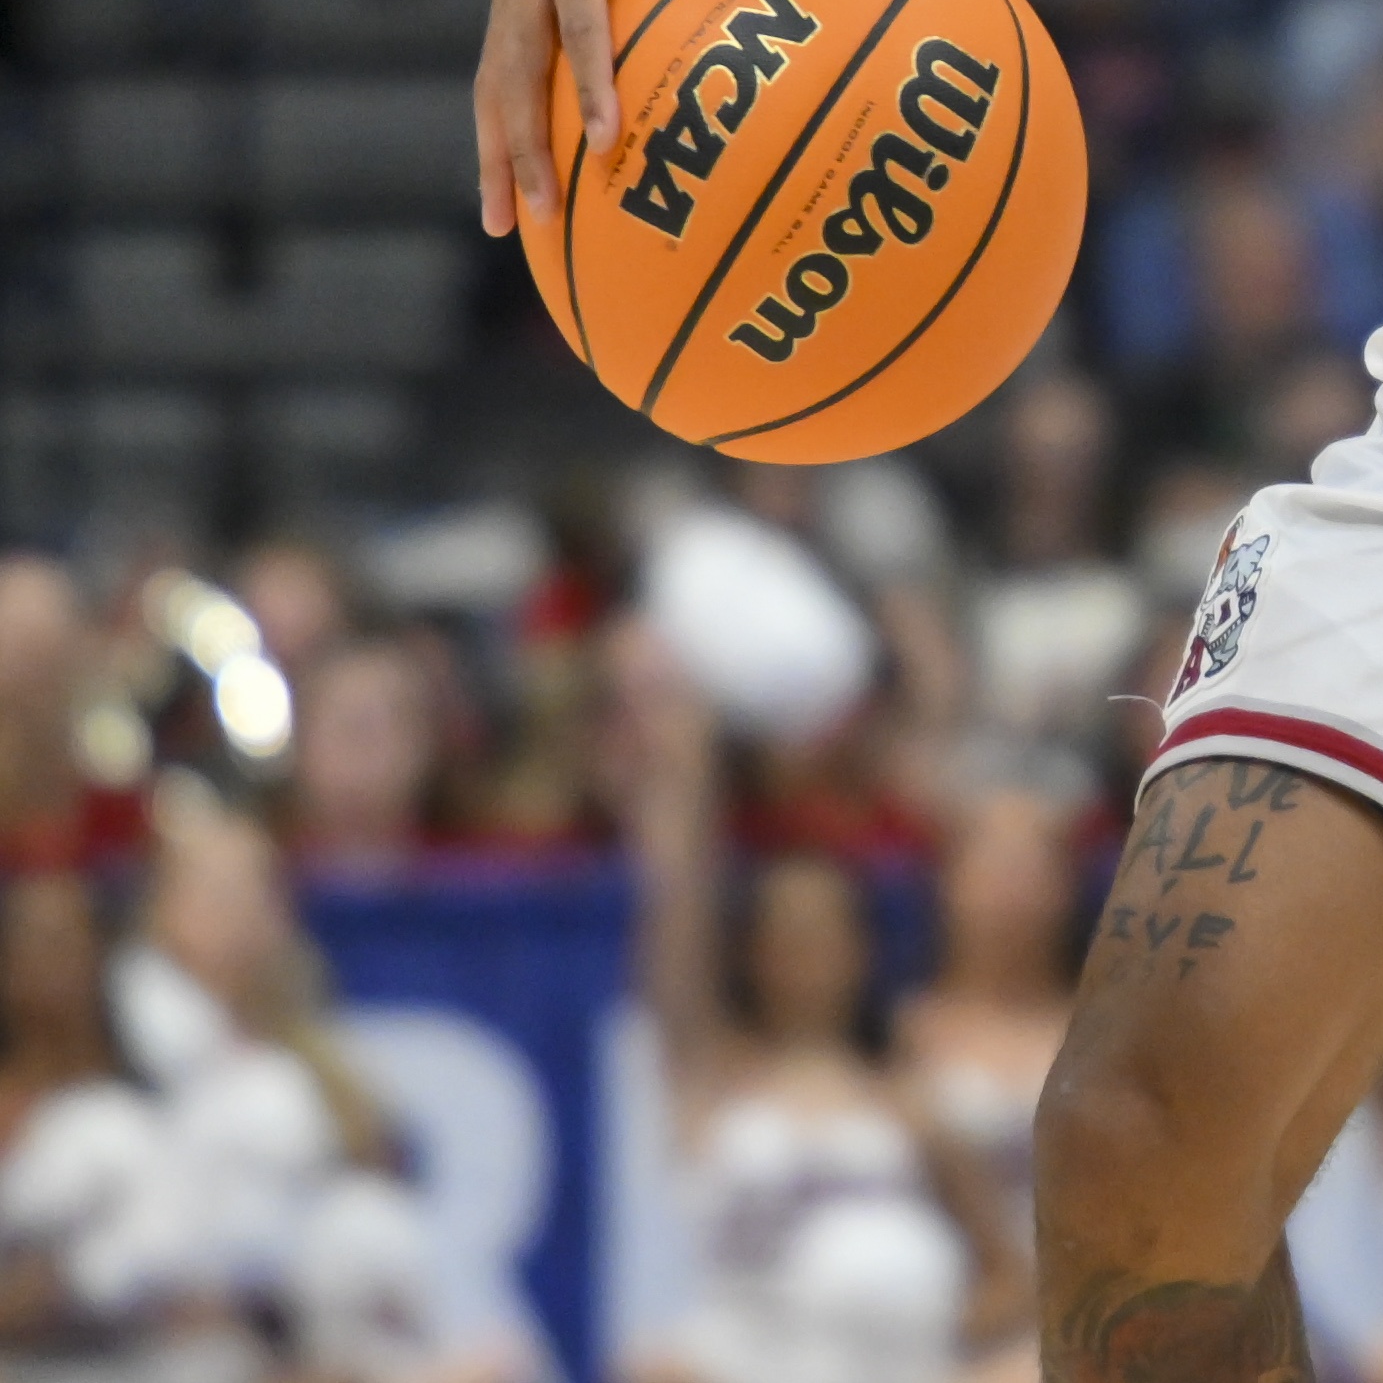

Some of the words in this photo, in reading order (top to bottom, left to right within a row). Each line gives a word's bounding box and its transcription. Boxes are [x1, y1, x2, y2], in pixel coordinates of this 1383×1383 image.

[637, 57, 683, 126] GAME
[604, 131, 638, 195] BALL
[727, 36, 1000, 363] Wilson
